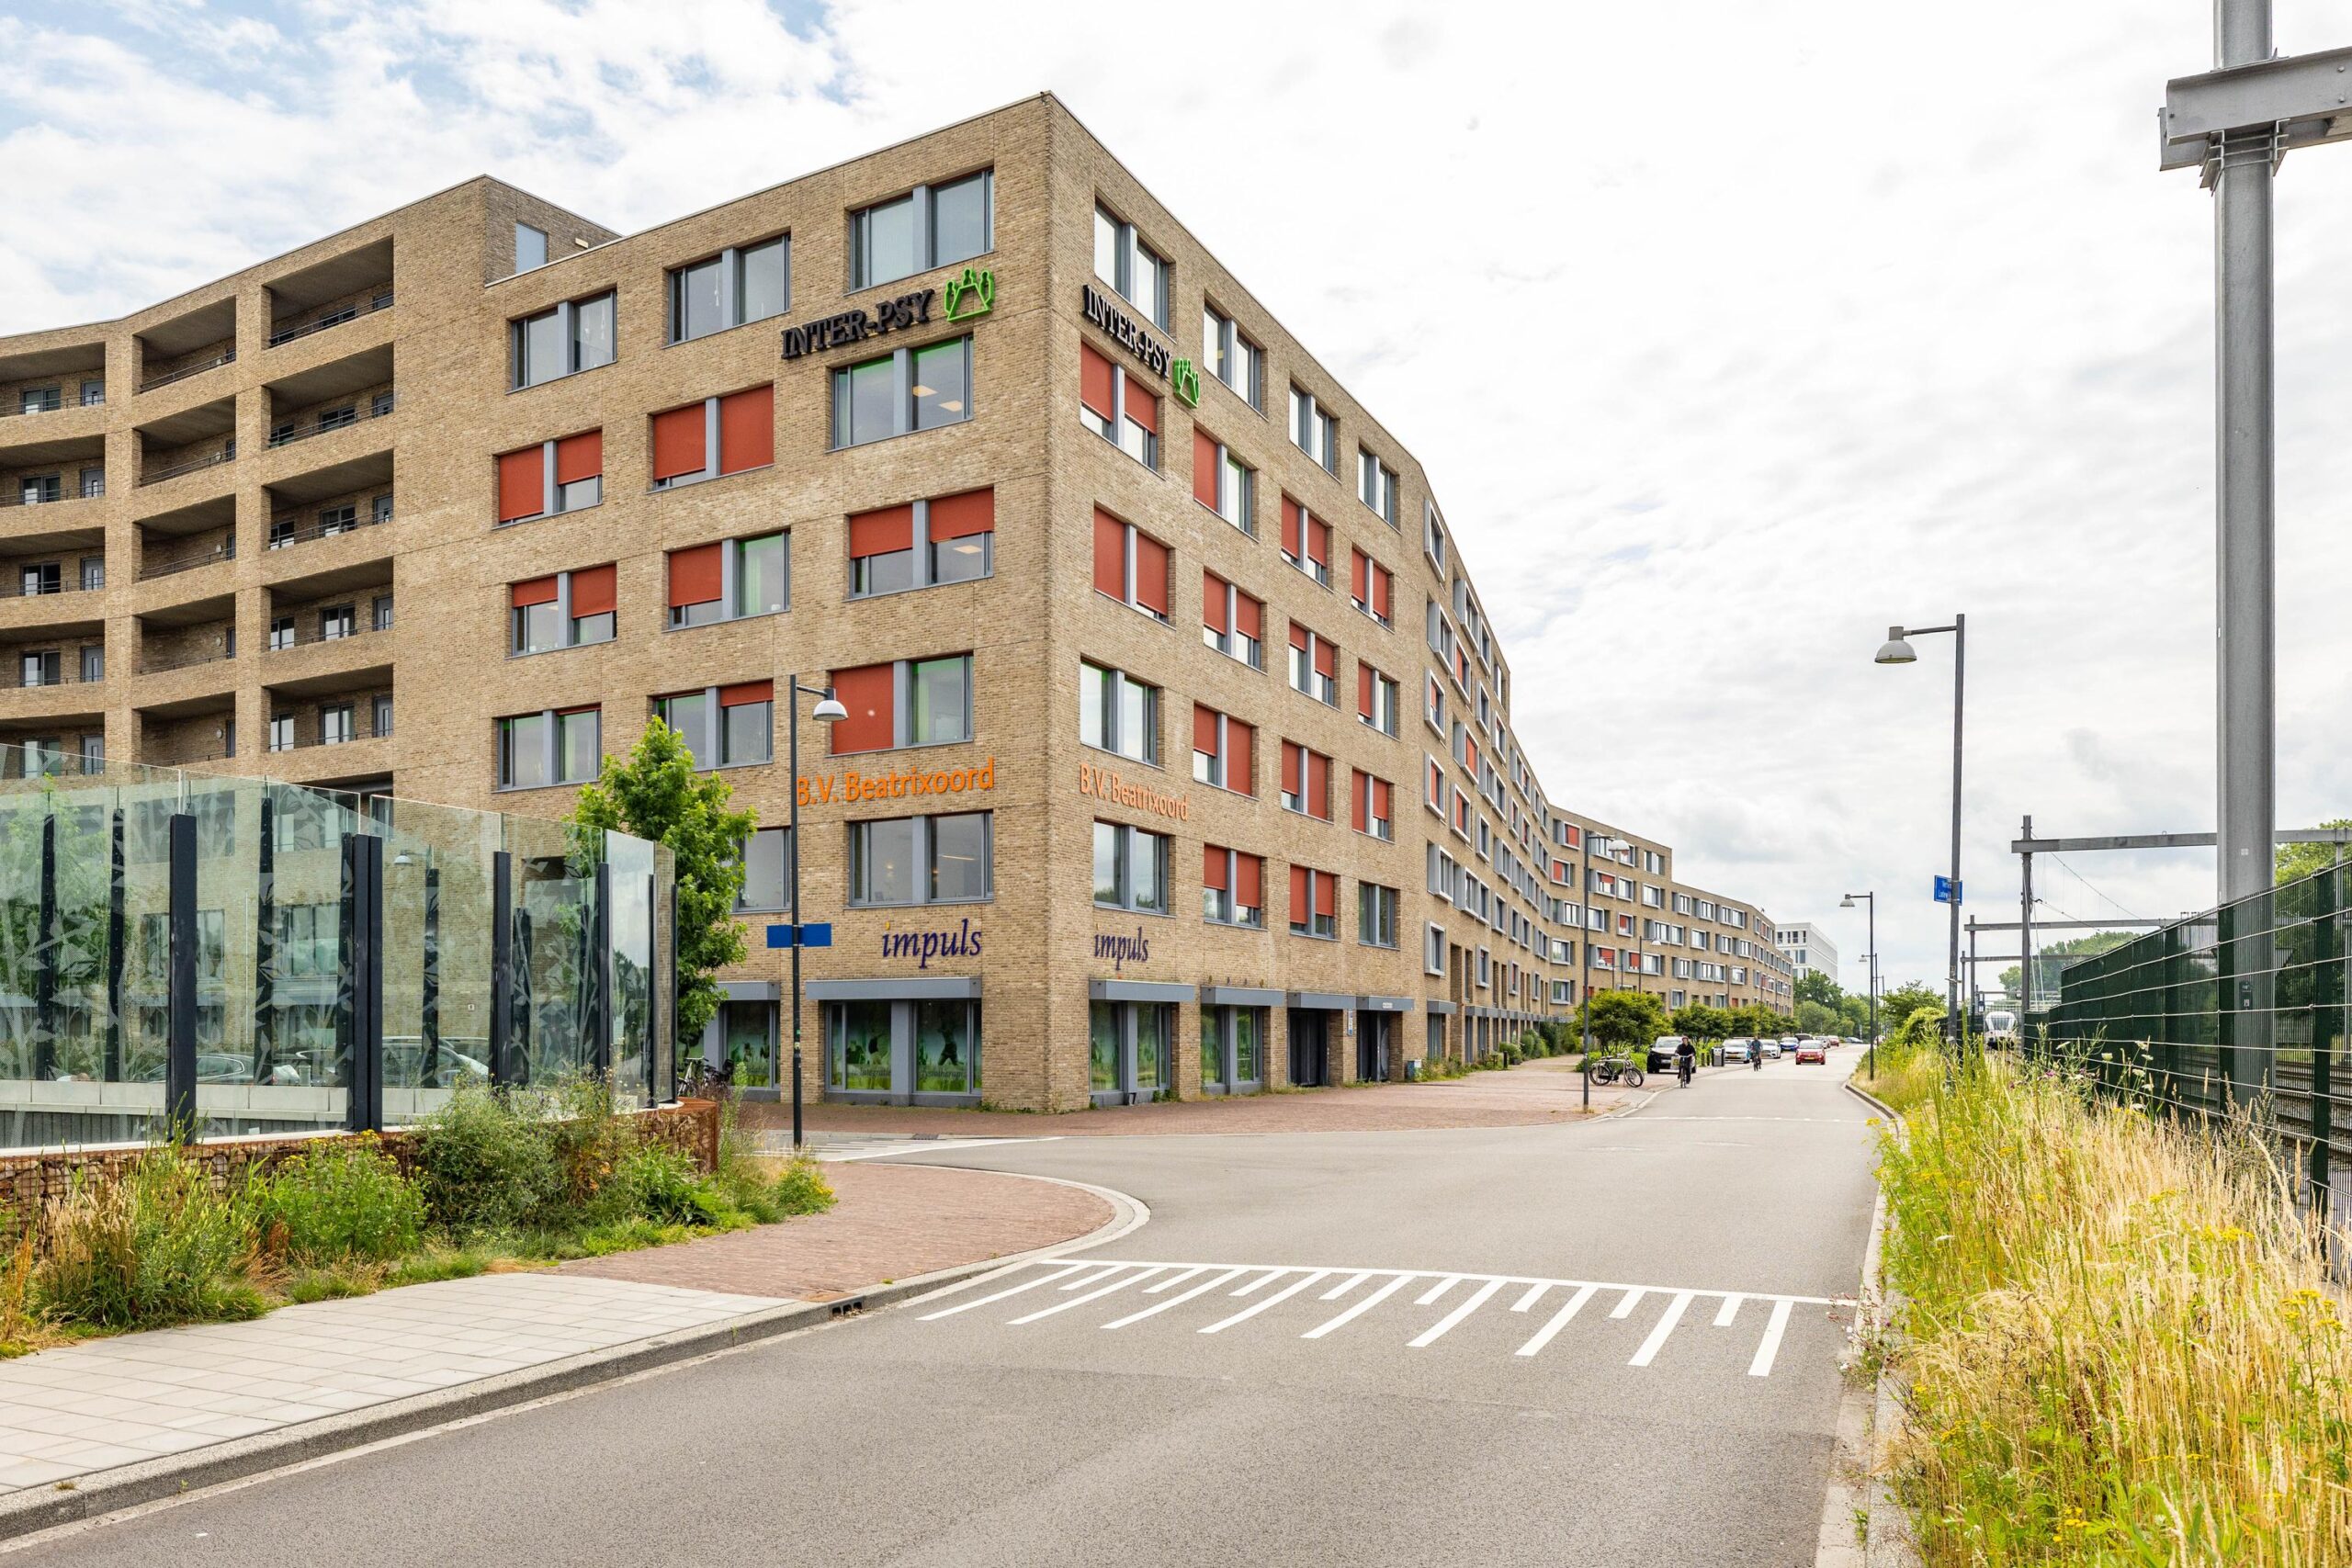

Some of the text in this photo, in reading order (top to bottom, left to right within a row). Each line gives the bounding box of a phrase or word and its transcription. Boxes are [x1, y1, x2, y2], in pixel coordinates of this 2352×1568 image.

[781, 288, 934, 359] INTER-PSY
[1083, 285, 1172, 379] INTER-PSY
[797, 756, 995, 806] B.V. Beatrixoord
[1080, 763, 1190, 821] B.V. Beatrixoord
[882, 918, 982, 969] impuls
[1094, 923, 1148, 971] impuls
